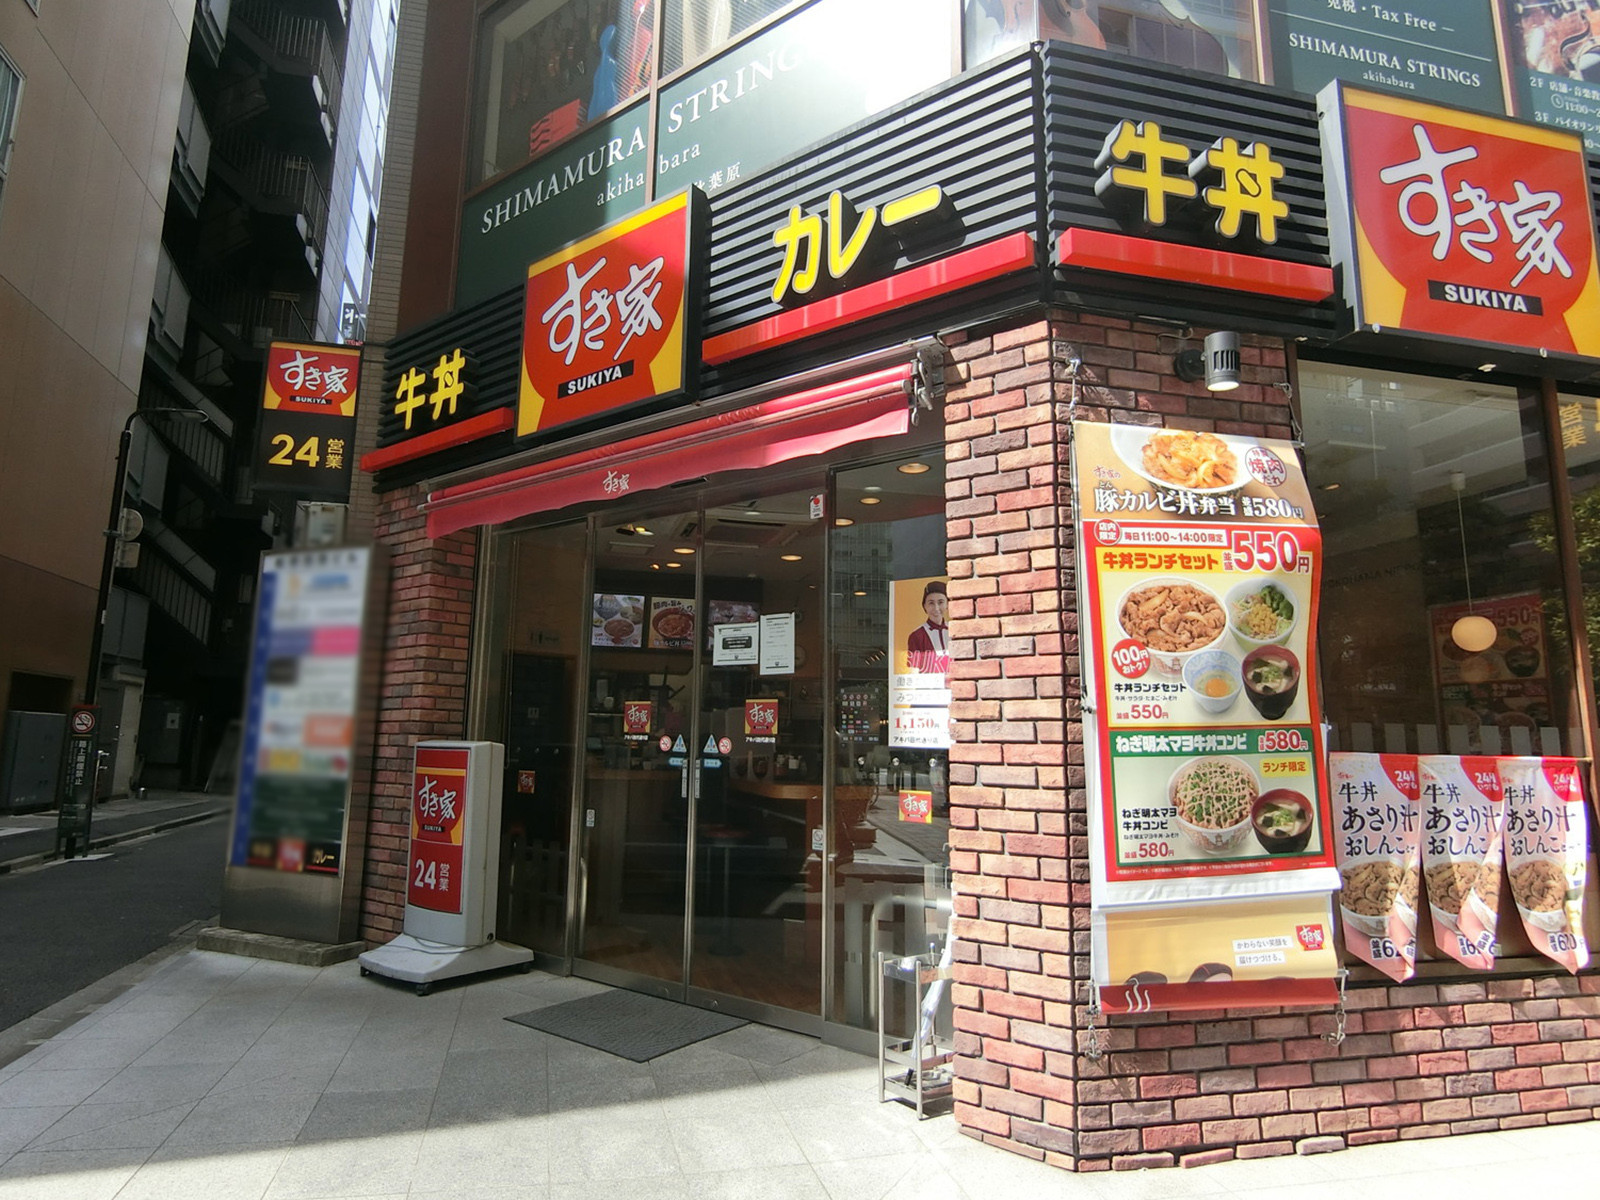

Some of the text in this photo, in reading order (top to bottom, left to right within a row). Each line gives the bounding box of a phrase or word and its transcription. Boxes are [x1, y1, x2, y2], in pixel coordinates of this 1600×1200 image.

[1404, 13, 1437, 32] Free
[1289, 33, 1481, 88] SHIMAMURA STRINGS
[1362, 70, 1415, 90] akihabara
[1529, 77, 1544, 88] 2F
[1534, 111, 1549, 123] 3F
[481, 125, 647, 234] SHIMAMURA
[1102, 119, 1291, 246] 牛丼
[1379, 123, 1573, 289] すき家
[771, 184, 943, 304] カレー
[1443, 283, 1529, 314] SUKIYA
[541, 256, 664, 366] すき家
[280, 350, 350, 397] すき家
[567, 364, 623, 395] SUKIYA
[295, 396, 328, 405] SUKIYA
[394, 347, 466, 431] 牛丼
[268, 433, 345, 470] 24 営業
[602, 470, 631, 494] すき家
[1094, 487, 1237, 517] 豚カルビ丼弁当
[1103, 552, 1219, 570] 牛丼ランチセット
[1114, 682, 1187, 693] 牛丼ランチセット
[627, 704, 648, 725] すき家
[748, 703, 775, 725] すき家
[1115, 732, 1248, 754] ねぎ明太マヨ牛丼コンビ
[1262, 761, 1306, 773] ランチ限定
[418, 776, 457, 824] すき家
[1338, 780, 1378, 803] 牛丼
[1423, 782, 1461, 804] 牛丼
[1504, 784, 1536, 806] 牛丼
[902, 794, 928, 814] すき家
[1122, 807, 1178, 819] ねぎ明太マヨ
[1122, 819, 1169, 831] 牛丼コンビ
[1342, 803, 1418, 834] あさり汁
[1425, 804, 1502, 834] あさり汁
[1507, 805, 1576, 834] あさり汁
[414, 859, 450, 892] 24 営業
[1299, 925, 1323, 944] すき家
